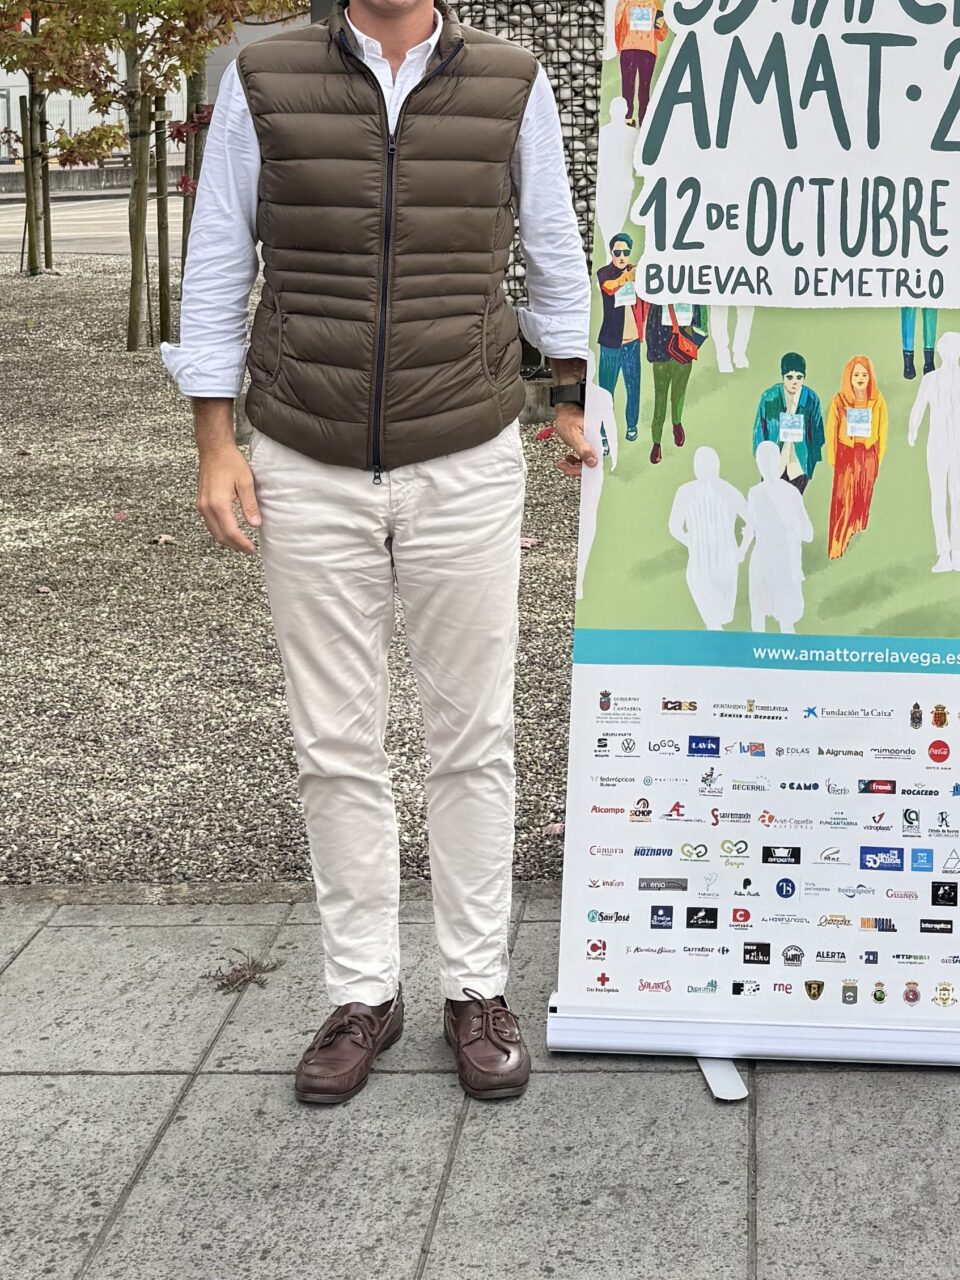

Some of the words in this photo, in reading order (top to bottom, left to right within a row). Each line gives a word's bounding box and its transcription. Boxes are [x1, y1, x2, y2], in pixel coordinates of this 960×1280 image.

[638, 176, 705, 252] 12
[706, 202, 740, 231] DE
[745, 176, 950, 259] OCTUBRE
[644, 263, 773, 296] BULEVAR
[661, 697, 698, 712] icass
[821, 708, 859, 717] Fundación
[825, 748, 864, 758] Algrumaq
[870, 747, 916, 755] mimoondo
[789, 782, 820, 791] CAMO
[901, 789, 940, 797] ROCACERO
[590, 805, 625, 815] Alcampo
[683, 946, 715, 954] Carrefour
[816, 951, 847, 959] ALERTA
[638, 979, 672, 992] SOLARES
[773, 982, 793, 994] rne
